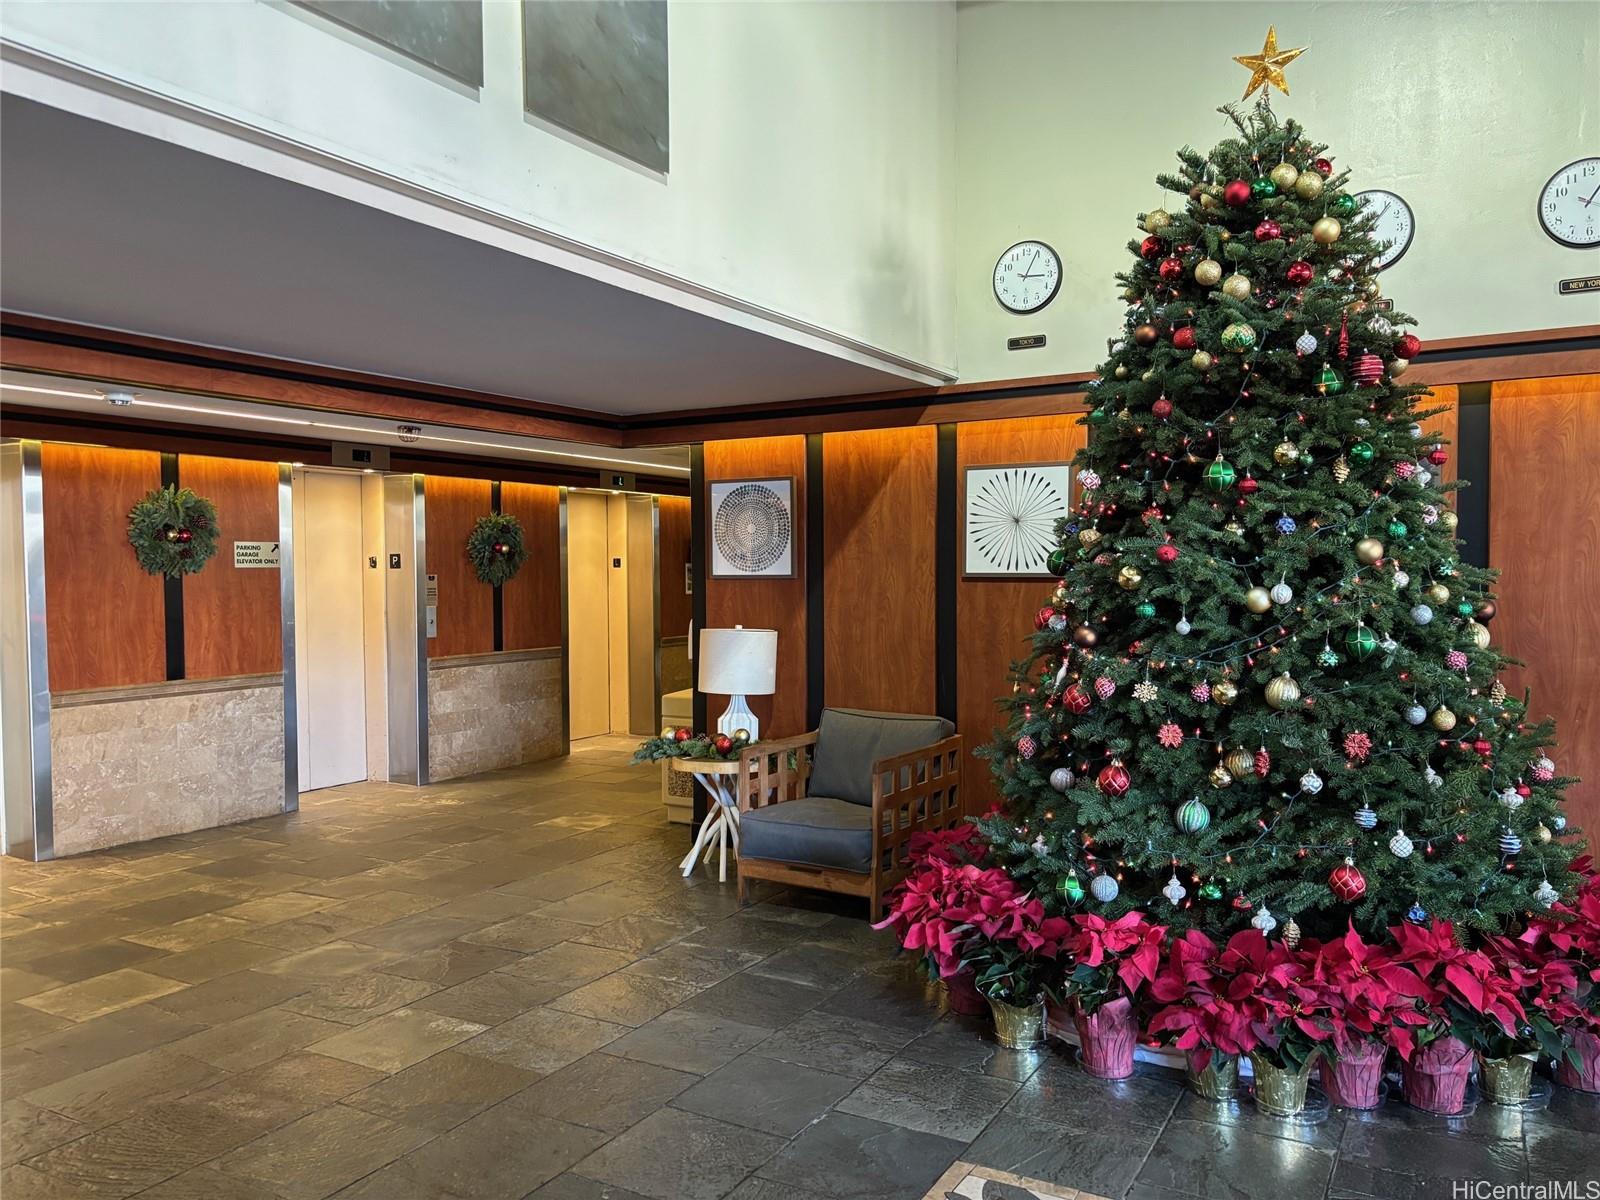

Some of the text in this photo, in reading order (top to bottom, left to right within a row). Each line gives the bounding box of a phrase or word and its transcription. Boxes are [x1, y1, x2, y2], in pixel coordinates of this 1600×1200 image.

[1583, 165, 1595, 176] 12
[1566, 174, 1577, 184] 11
[1555, 187, 1568, 197] 10
[1549, 203, 1556, 212] 9
[1393, 210, 1399, 218] 2
[1555, 216, 1562, 225] 8
[1396, 222, 1403, 231] 3
[1569, 225, 1575, 234] 7
[1586, 226, 1593, 236] 6
[1022, 248, 1031, 256] 12
[1011, 253, 1019, 262] 11
[1004, 263, 1013, 272] 10
[1045, 259, 1050, 267] 2
[1047, 270, 1053, 278] 3
[1000, 276, 1005, 284] 9
[1569, 281, 1585, 289] NEW
[392, 556, 398, 565] P
